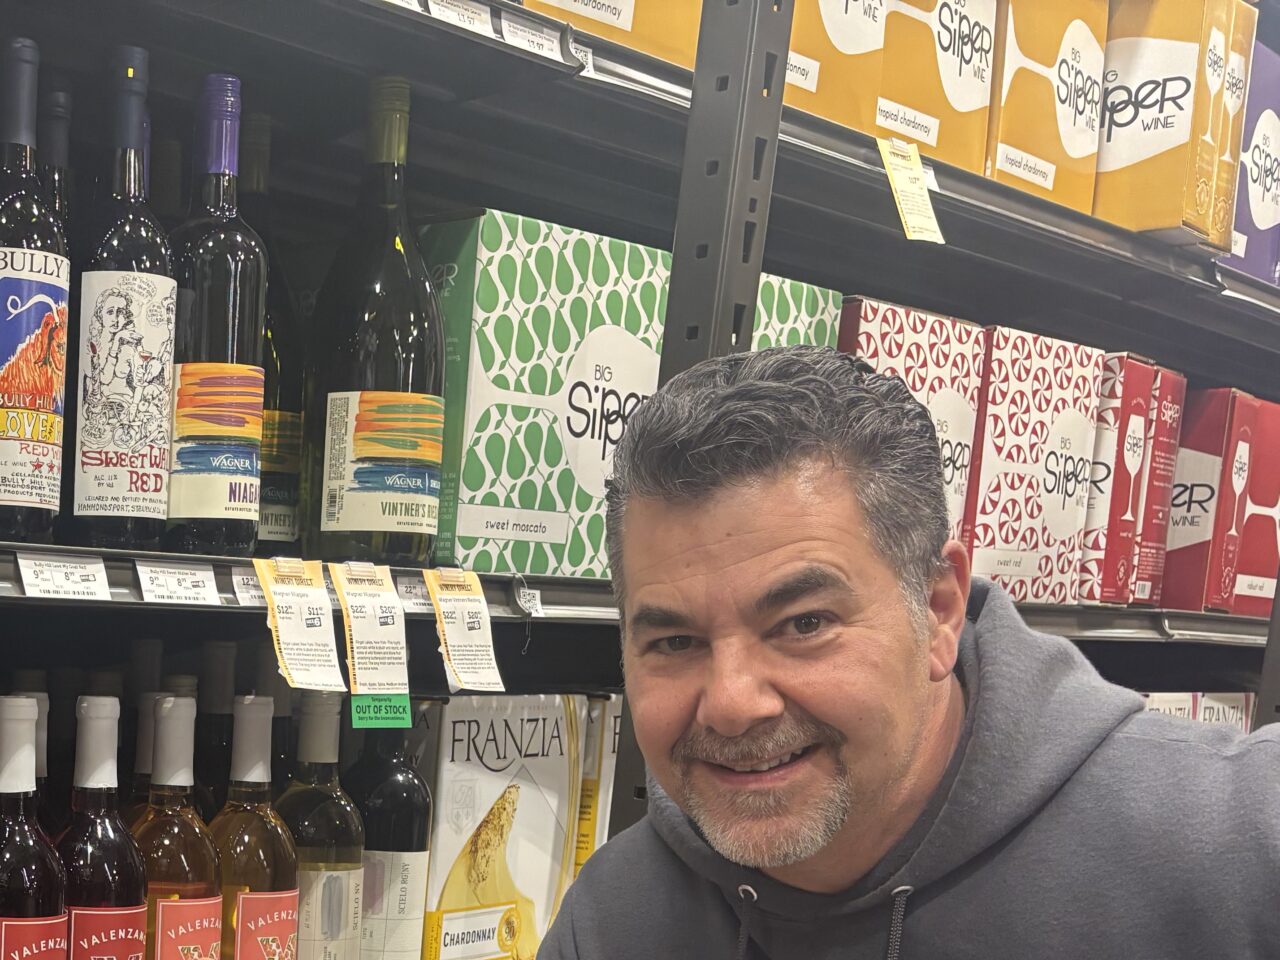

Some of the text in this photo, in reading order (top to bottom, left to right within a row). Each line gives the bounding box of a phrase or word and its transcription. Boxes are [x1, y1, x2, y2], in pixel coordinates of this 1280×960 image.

[878, 106, 932, 137] tropical chardonnay
[1141, 115, 1176, 131] WINE
[594, 364, 612, 381] BIG
[19, 442, 50, 458] RED
[1060, 437, 1072, 449] BIG
[81, 449, 148, 473] SWEET
[210, 453, 252, 471] WAGNER
[127, 470, 163, 493] RED
[384, 473, 423, 489] WAGNER
[228, 482, 260, 504] NIAGA
[380, 501, 426, 518] VINTNER'S
[485, 519, 547, 534] sweet moscato
[1171, 515, 1201, 527] WINE
[355, 704, 408, 715] OUT OF STOCK
[450, 716, 564, 772] FRANZIA
[443, 927, 497, 947] CHARDONNAY
